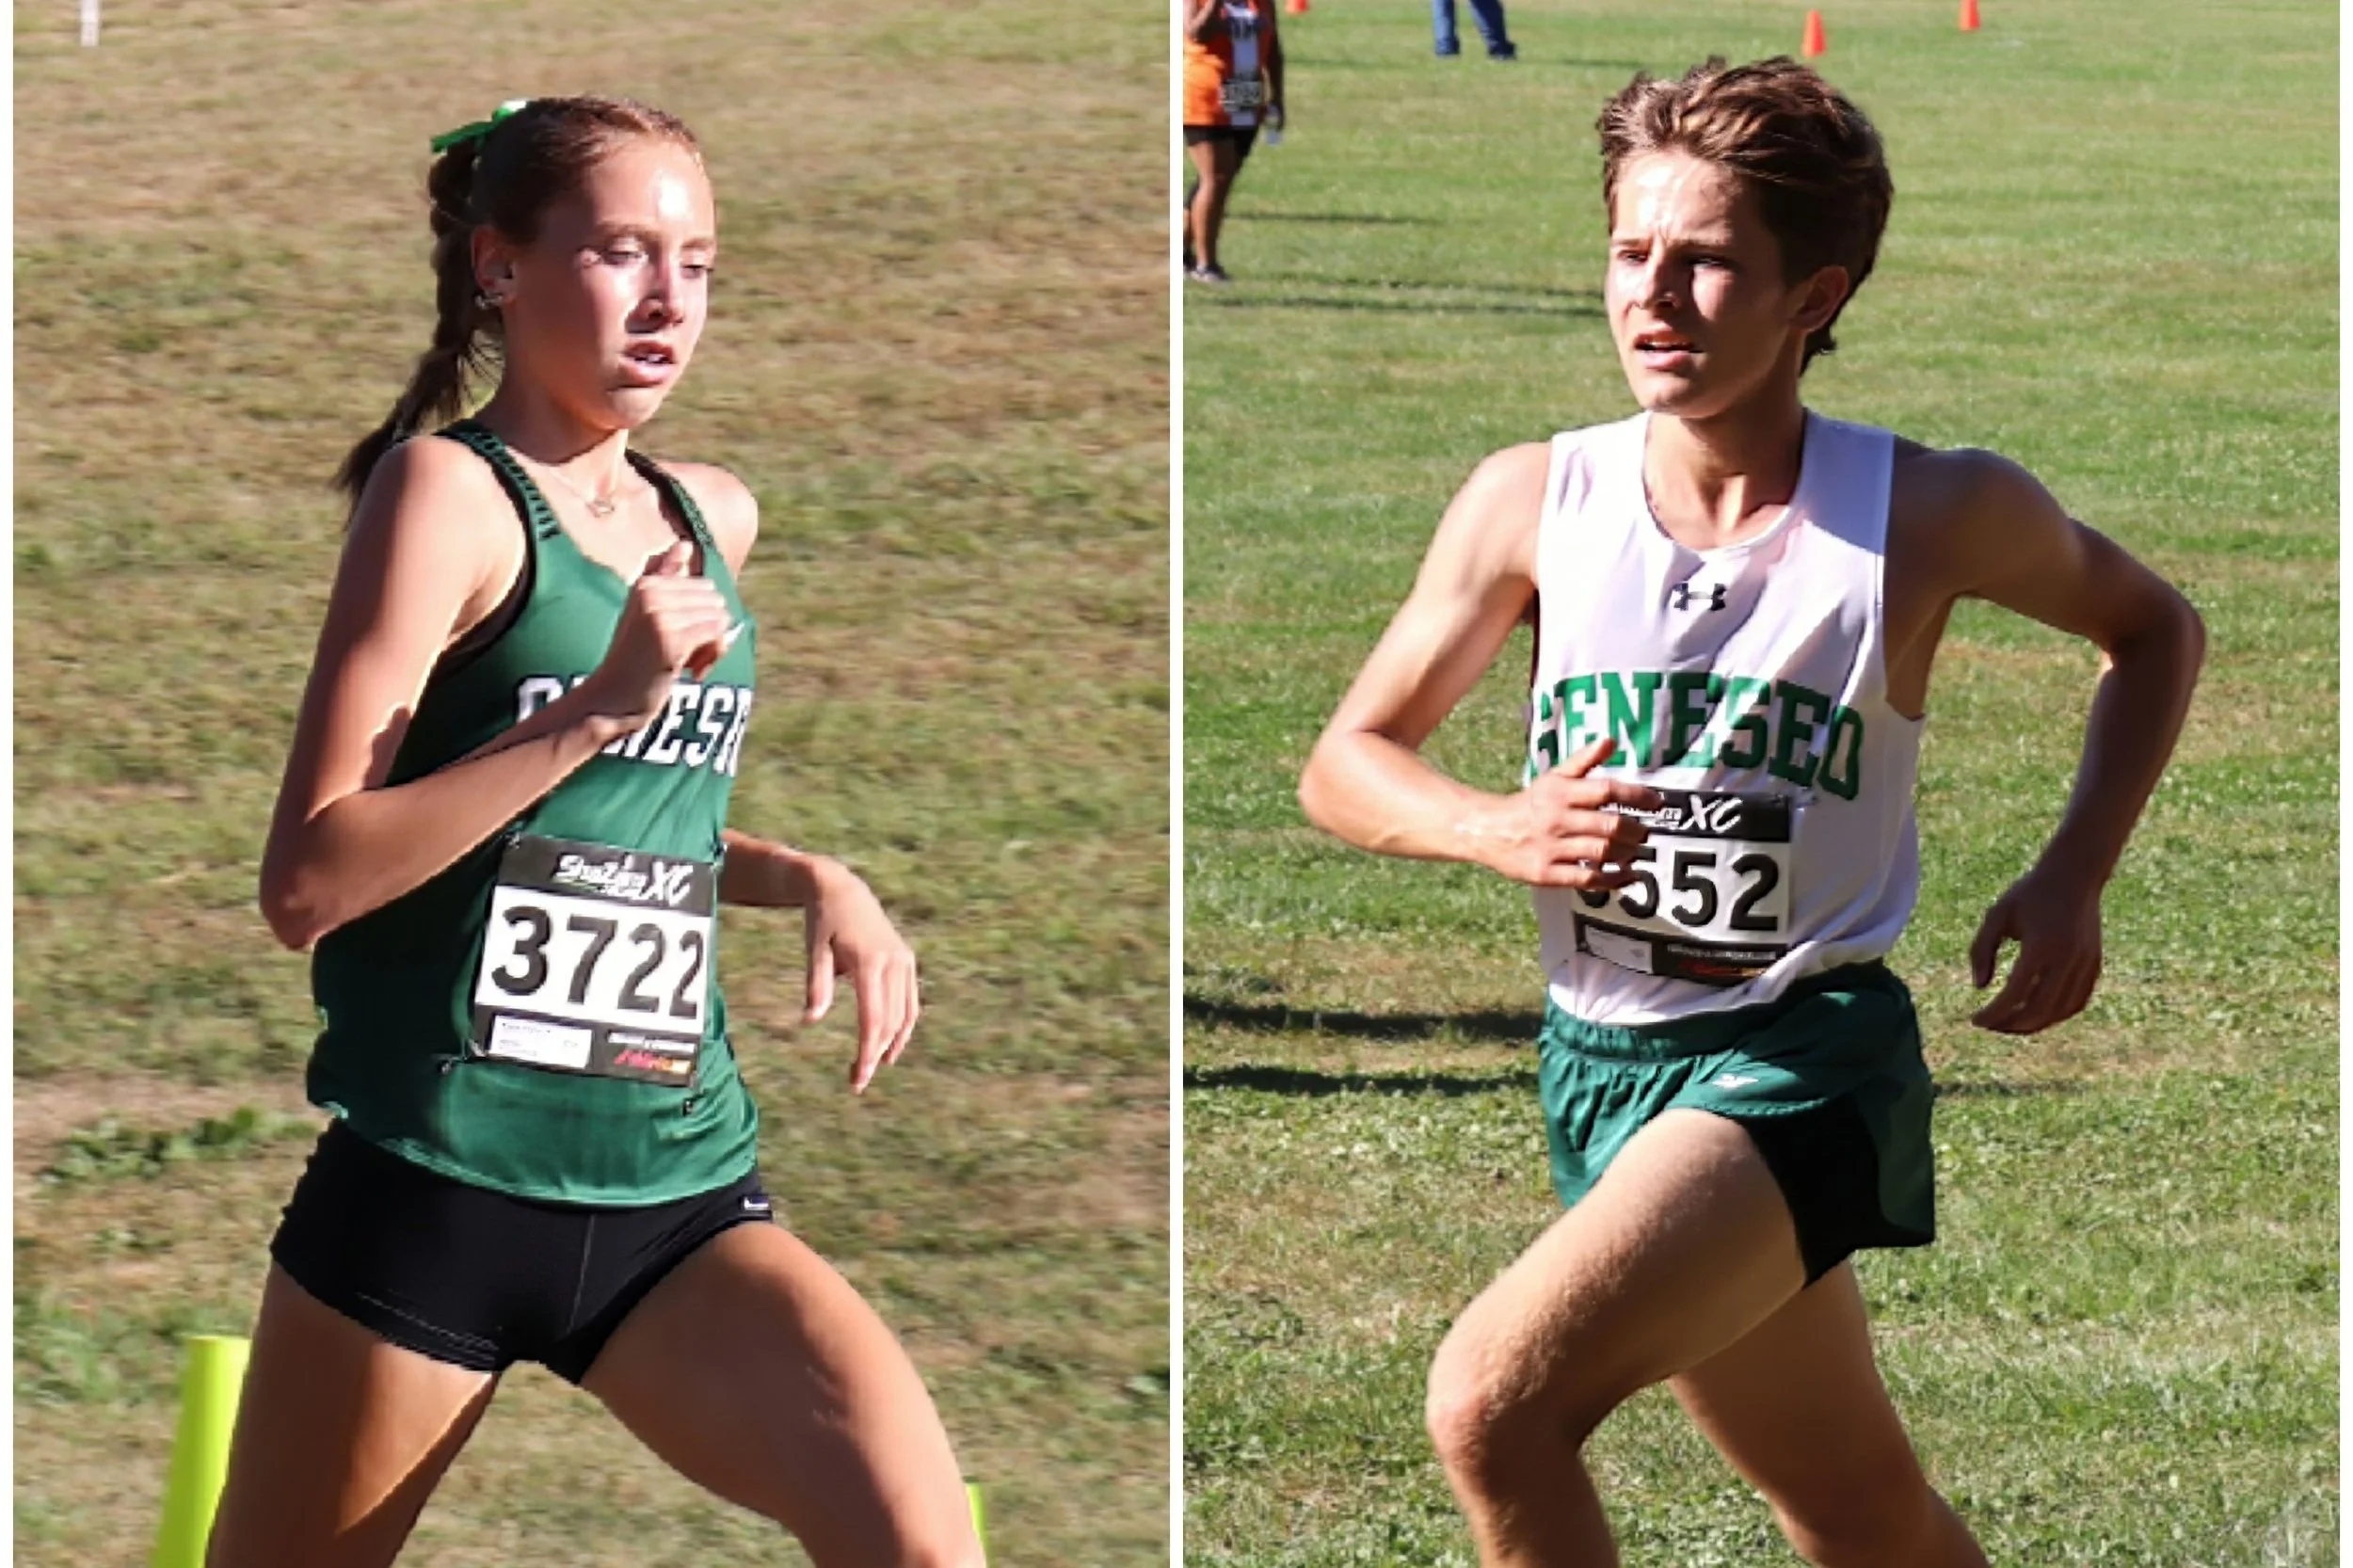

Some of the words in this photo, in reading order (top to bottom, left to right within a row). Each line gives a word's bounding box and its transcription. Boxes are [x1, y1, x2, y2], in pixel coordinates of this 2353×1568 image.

[1679, 793, 1743, 834] XC
[638, 861, 694, 906] XC
[1577, 846, 1779, 932] 552
[490, 905, 704, 1019] 3722
